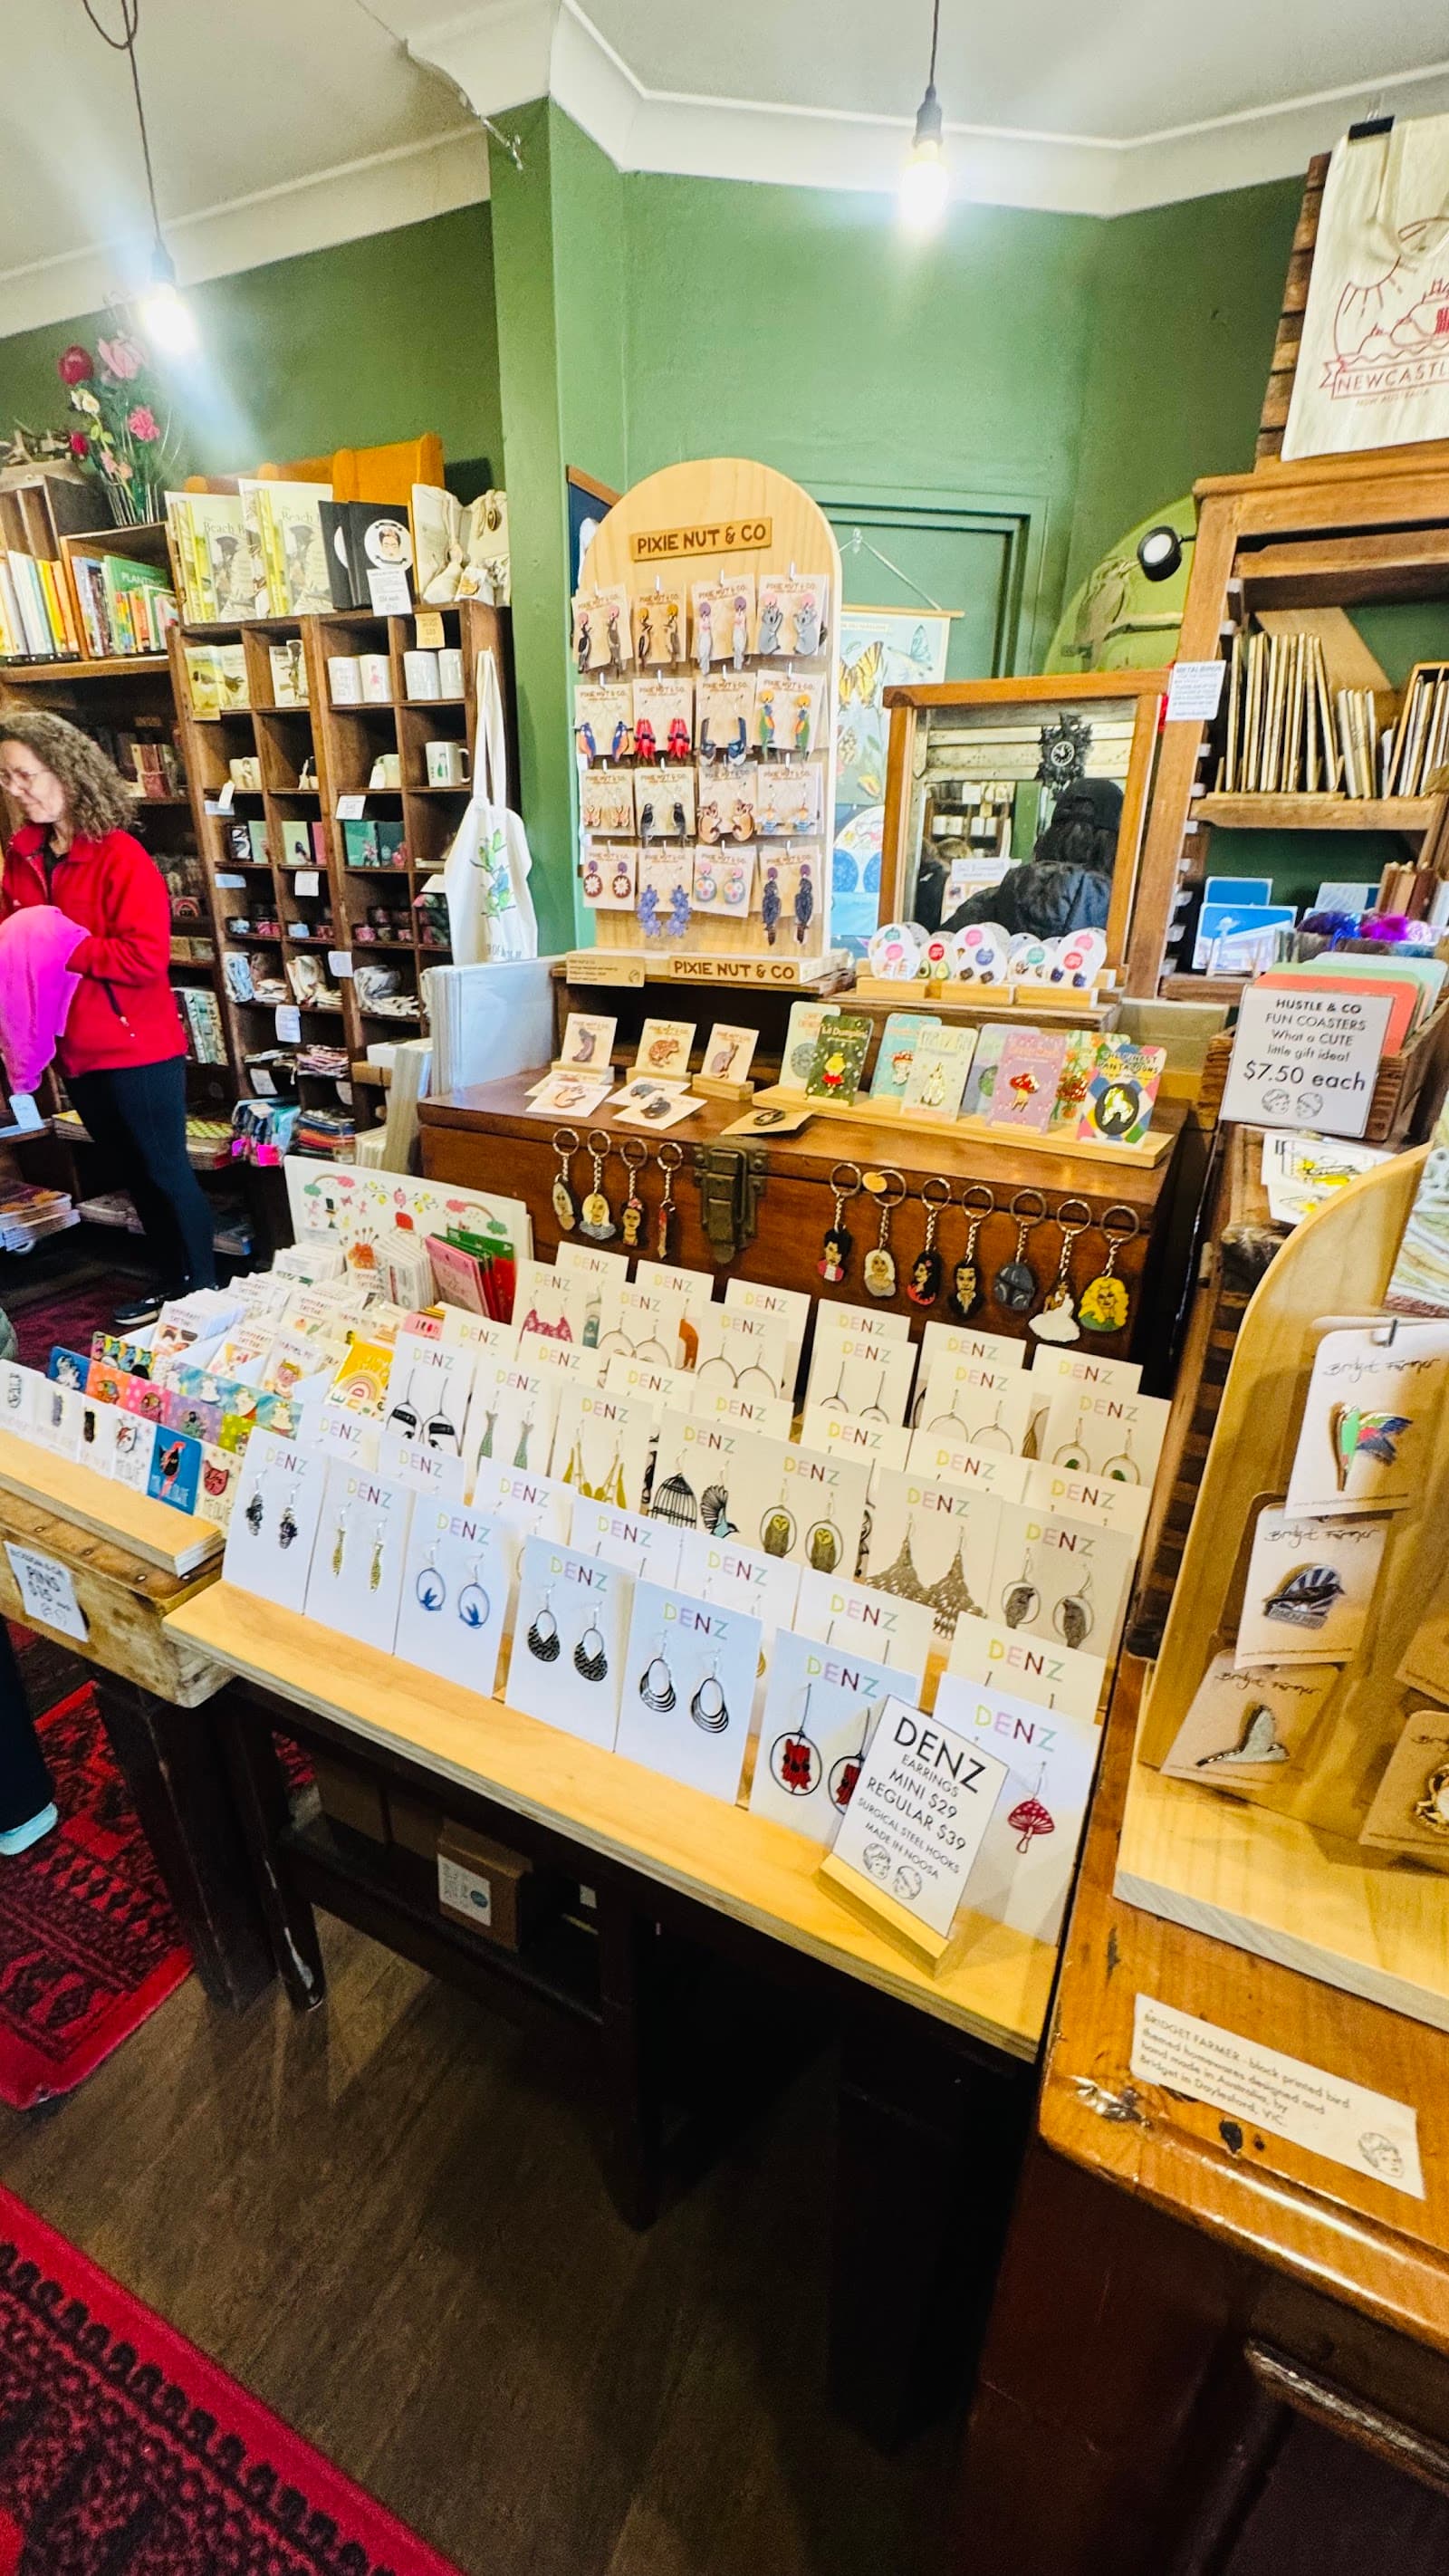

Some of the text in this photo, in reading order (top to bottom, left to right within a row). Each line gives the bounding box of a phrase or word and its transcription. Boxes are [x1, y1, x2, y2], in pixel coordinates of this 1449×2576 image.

[1338, 360, 1449, 392] NEWCASTL
[637, 524, 766, 553] PIXIE NUT & CO
[674, 960, 795, 979] PIXIE NUT & CO
[1276, 999, 1362, 1014] HUSTLE & CO
[1265, 1013, 1368, 1031] FUN COASTERS
[1267, 1044, 1291, 1057] little
[1295, 1047, 1315, 1060] gift
[1271, 1029, 1355, 1046] What a CUTE
[1243, 1060, 1366, 1091] $7.50 each
[573, 1254, 609, 1274] DENZ
[534, 1272, 571, 1292] DENZ
[654, 1274, 694, 1293] DENZ
[620, 1292, 660, 1312] DENZ
[744, 1292, 788, 1312] DENZ
[460, 1324, 500, 1346] DENZ
[721, 1315, 767, 1337] DENZ
[839, 1313, 885, 1336] DENZ
[413, 1346, 456, 1370] DENZ
[539, 1347, 581, 1370] DENZ
[842, 1341, 891, 1364] DENZ
[946, 1337, 999, 1361] DENZ
[495, 1370, 541, 1394] DENZ
[628, 1370, 673, 1394] DENZ
[955, 1367, 1010, 1392] DENZ
[1059, 1360, 1114, 1386] DENZ
[581, 1398, 629, 1424] DENZ
[716, 1397, 767, 1422] DENZ
[1080, 1395, 1138, 1422] DENZ
[319, 1416, 362, 1446] DENZ
[683, 1426, 735, 1454] DENZ
[827, 1422, 883, 1449] DENZ
[264, 1446, 307, 1477] DENZ
[398, 1448, 443, 1479] DENZ
[783, 1456, 841, 1485] DENZ
[936, 1450, 996, 1480] DENZ
[347, 1476, 391, 1510] DENZ
[499, 1477, 550, 1507] DENZ
[907, 1486, 970, 1519] DENZ
[1051, 1479, 1116, 1511] DENZ
[436, 1512, 491, 1545] DENZ
[598, 1515, 652, 1548] DENZ
[1025, 1523, 1095, 1558] DENZ
[550, 1556, 608, 1591] DENZ
[707, 1551, 768, 1587] DENZ
[663, 1601, 728, 1640] DENZ
[830, 1594, 898, 1632] DENZ
[988, 1639, 1064, 1682] DENZ
[806, 1655, 880, 1698] DENZ
[974, 1704, 1058, 1753] DENZ
[893, 1716, 986, 1793] DENZ
[901, 1754, 960, 1798] EARRINGS
[889, 1768, 958, 1819] MINI $29
[867, 1776, 966, 1850] REGULAR $39
[858, 1798, 960, 1874] SURGICAL STEEL HOOKS
[865, 1821, 939, 1879] MADE IN NOOSA
[1140, 2053, 1177, 2081] Bridget
[1181, 2072, 1190, 2084] in
[1144, 2013, 1349, 2110] BRIDGET FARMER block printed bird
[1141, 2041, 1166, 2060] hand
[1171, 2054, 1199, 2074] made
[1204, 2069, 1213, 2081] in
[1274, 2100, 1287, 2114] by
[1303, 2098, 1324, 2115] and
